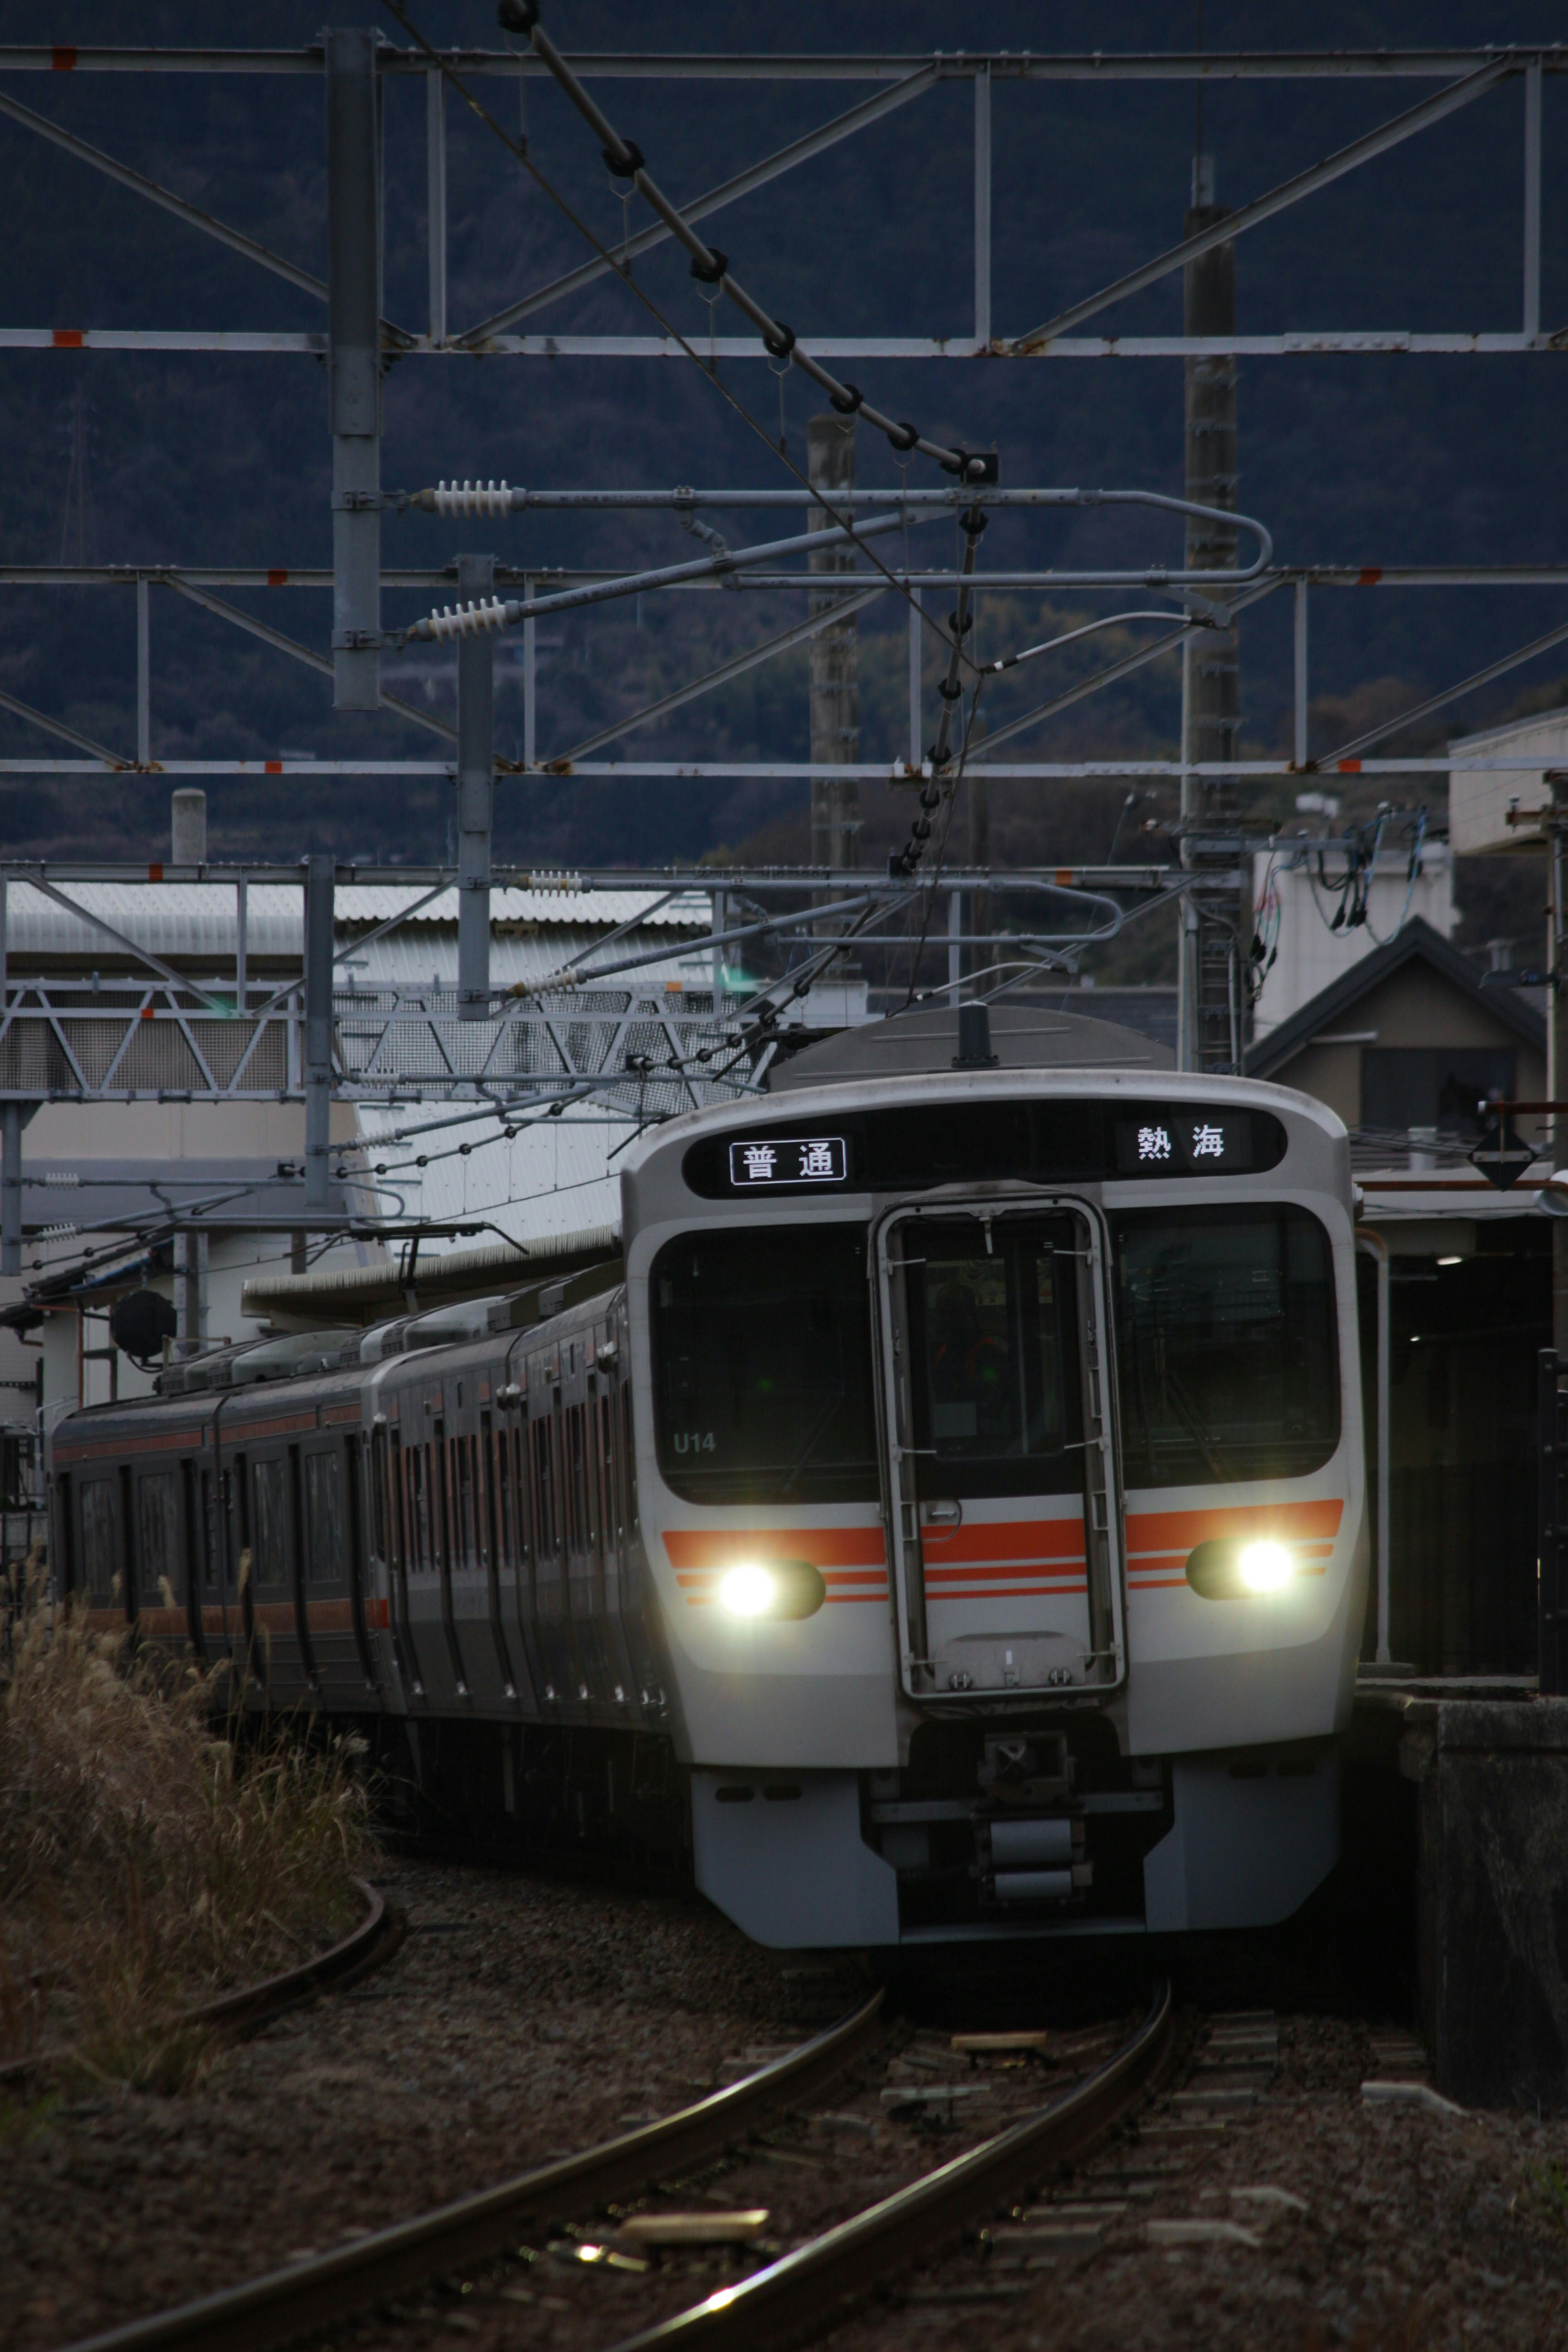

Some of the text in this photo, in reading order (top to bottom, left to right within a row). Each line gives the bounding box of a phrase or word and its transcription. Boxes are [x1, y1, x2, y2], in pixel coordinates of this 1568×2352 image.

[1137, 1124, 1225, 1160] 熱海
[743, 1142, 834, 1179] 普通
[674, 1432, 716, 1454] U14
